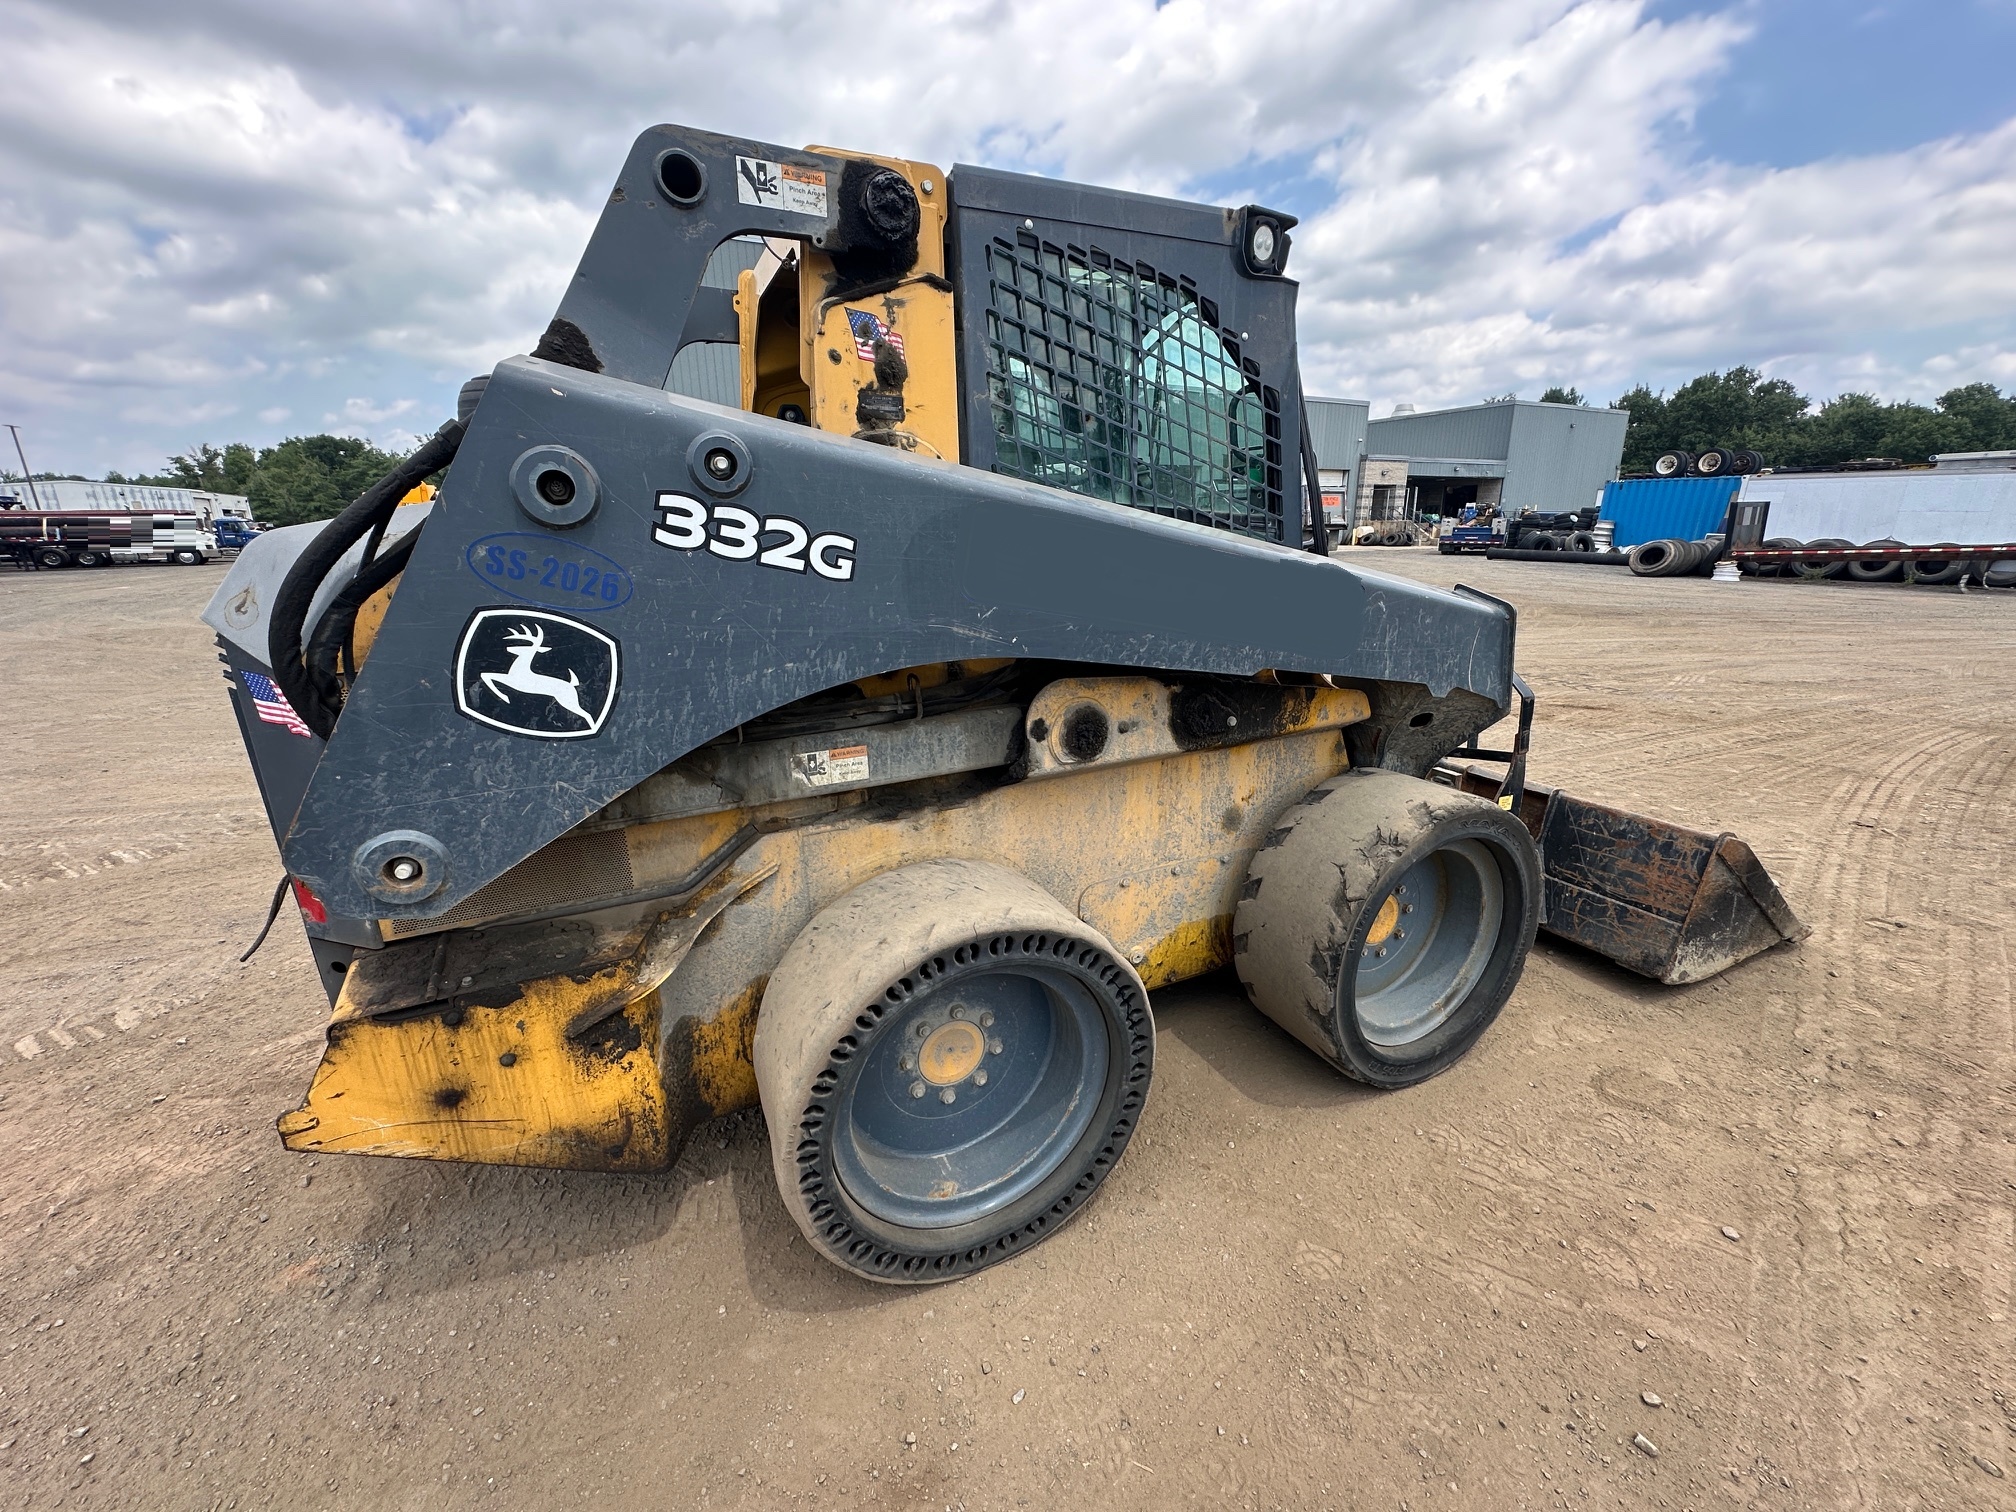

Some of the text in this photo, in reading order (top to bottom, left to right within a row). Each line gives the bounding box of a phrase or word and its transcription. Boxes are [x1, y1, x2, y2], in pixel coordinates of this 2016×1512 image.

[789, 185, 820, 197] Pinch Area
[791, 170, 822, 182] WRNING
[652, 491, 857, 581] 332G
[486, 545, 619, 603] SS-2026
